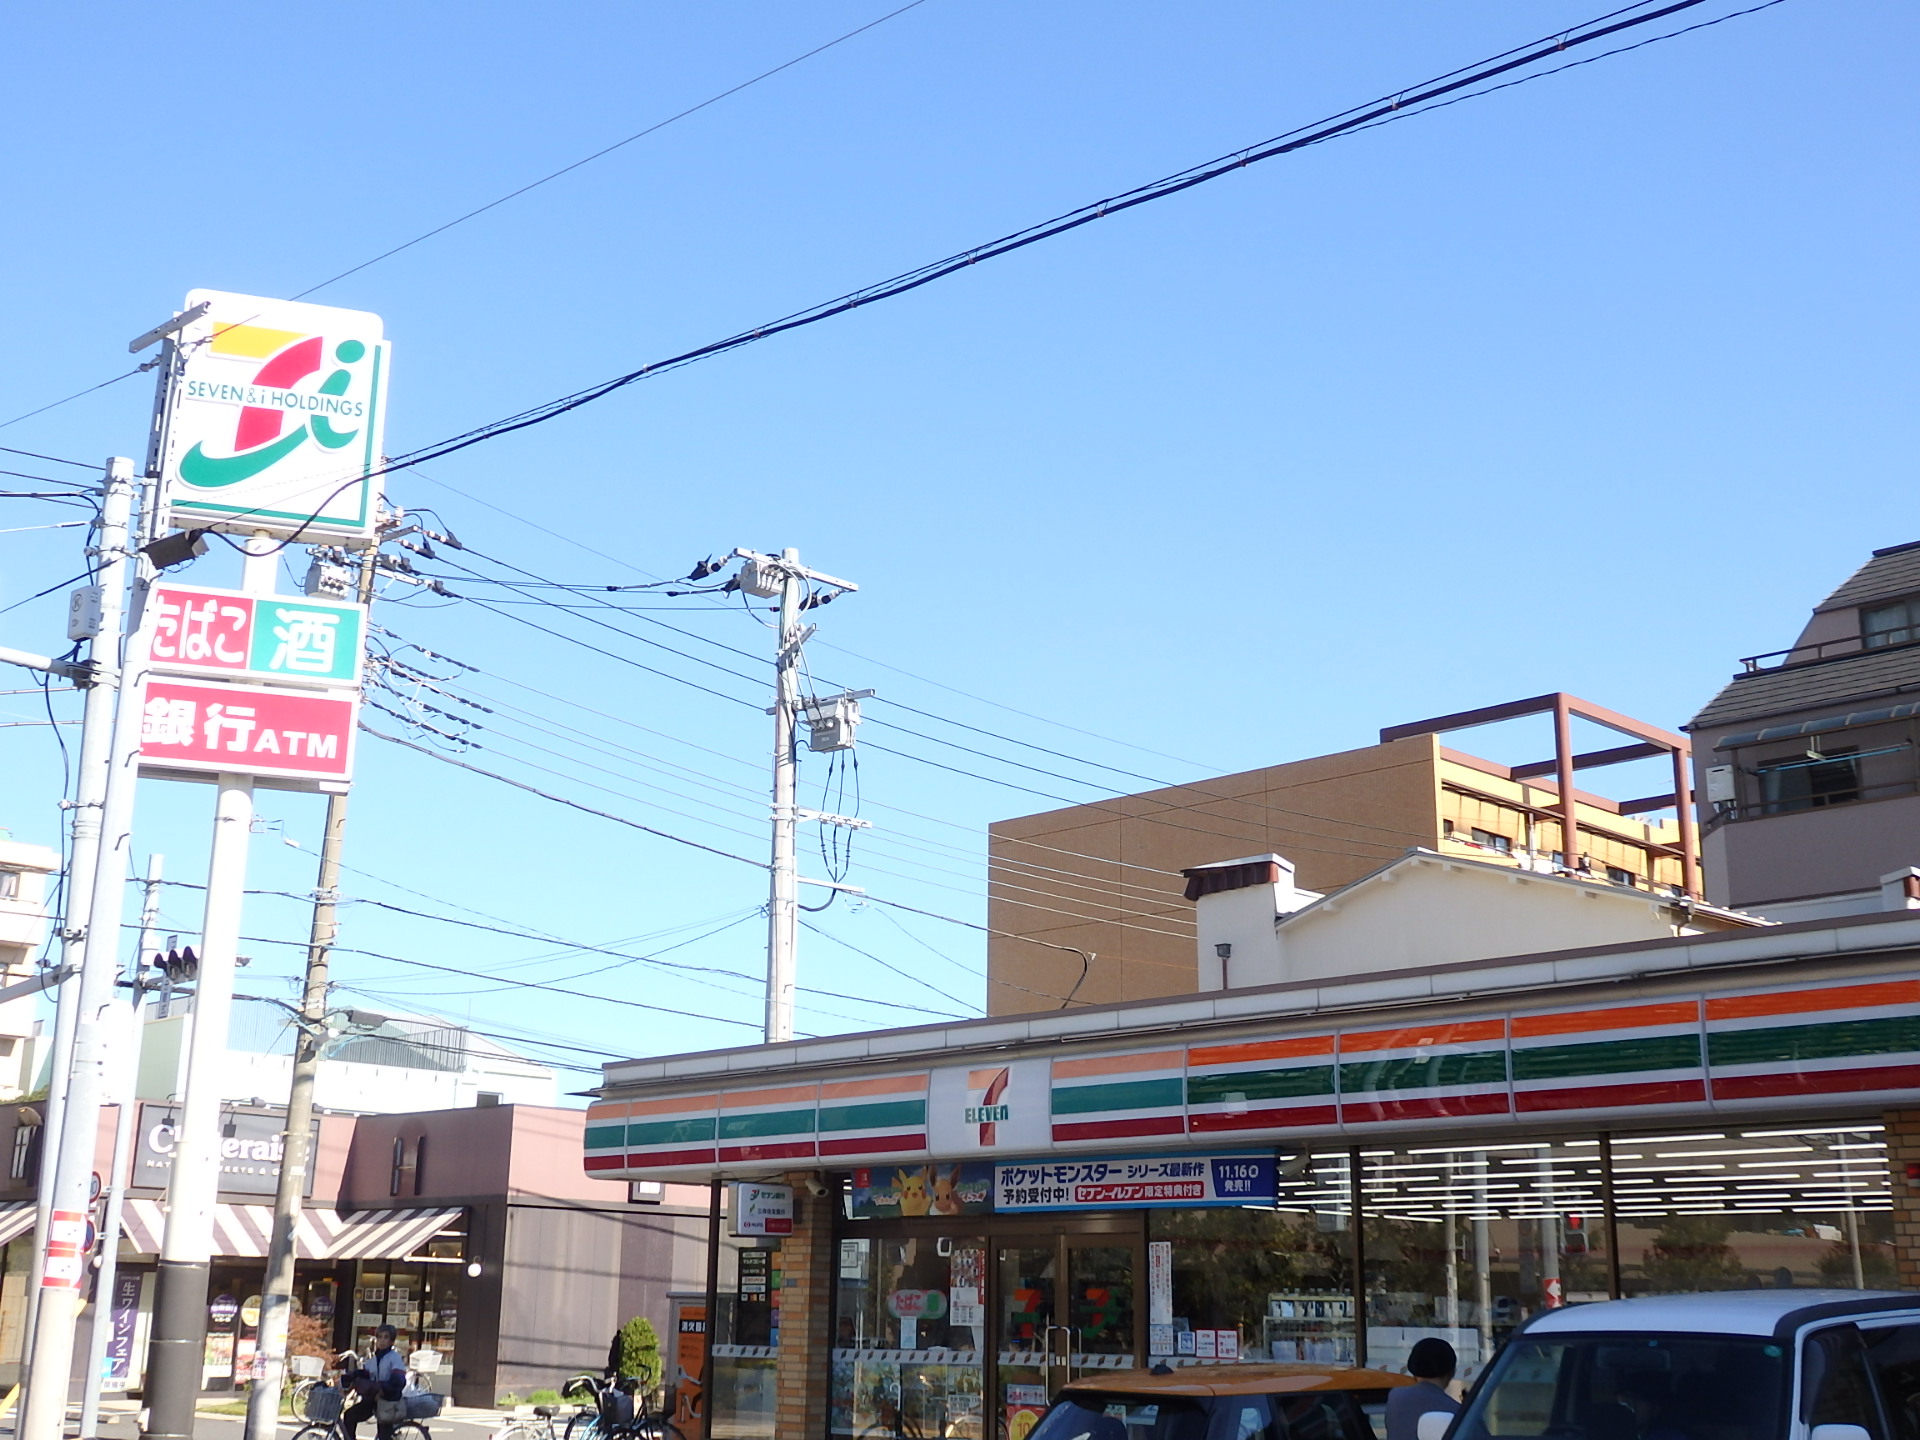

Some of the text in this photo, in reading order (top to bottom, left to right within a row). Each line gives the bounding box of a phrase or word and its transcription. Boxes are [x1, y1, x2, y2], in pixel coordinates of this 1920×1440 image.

[271, 391, 363, 417] HOLDINGS
[153, 594, 247, 664] たばこ
[268, 607, 341, 674] 酒
[1001, 1161, 1205, 1187] ポケットモンスター シリーズ最新作
[1003, 1186, 1070, 1205] 予約受付中!
[111, 1282, 136, 1372] 生ワインフェア
